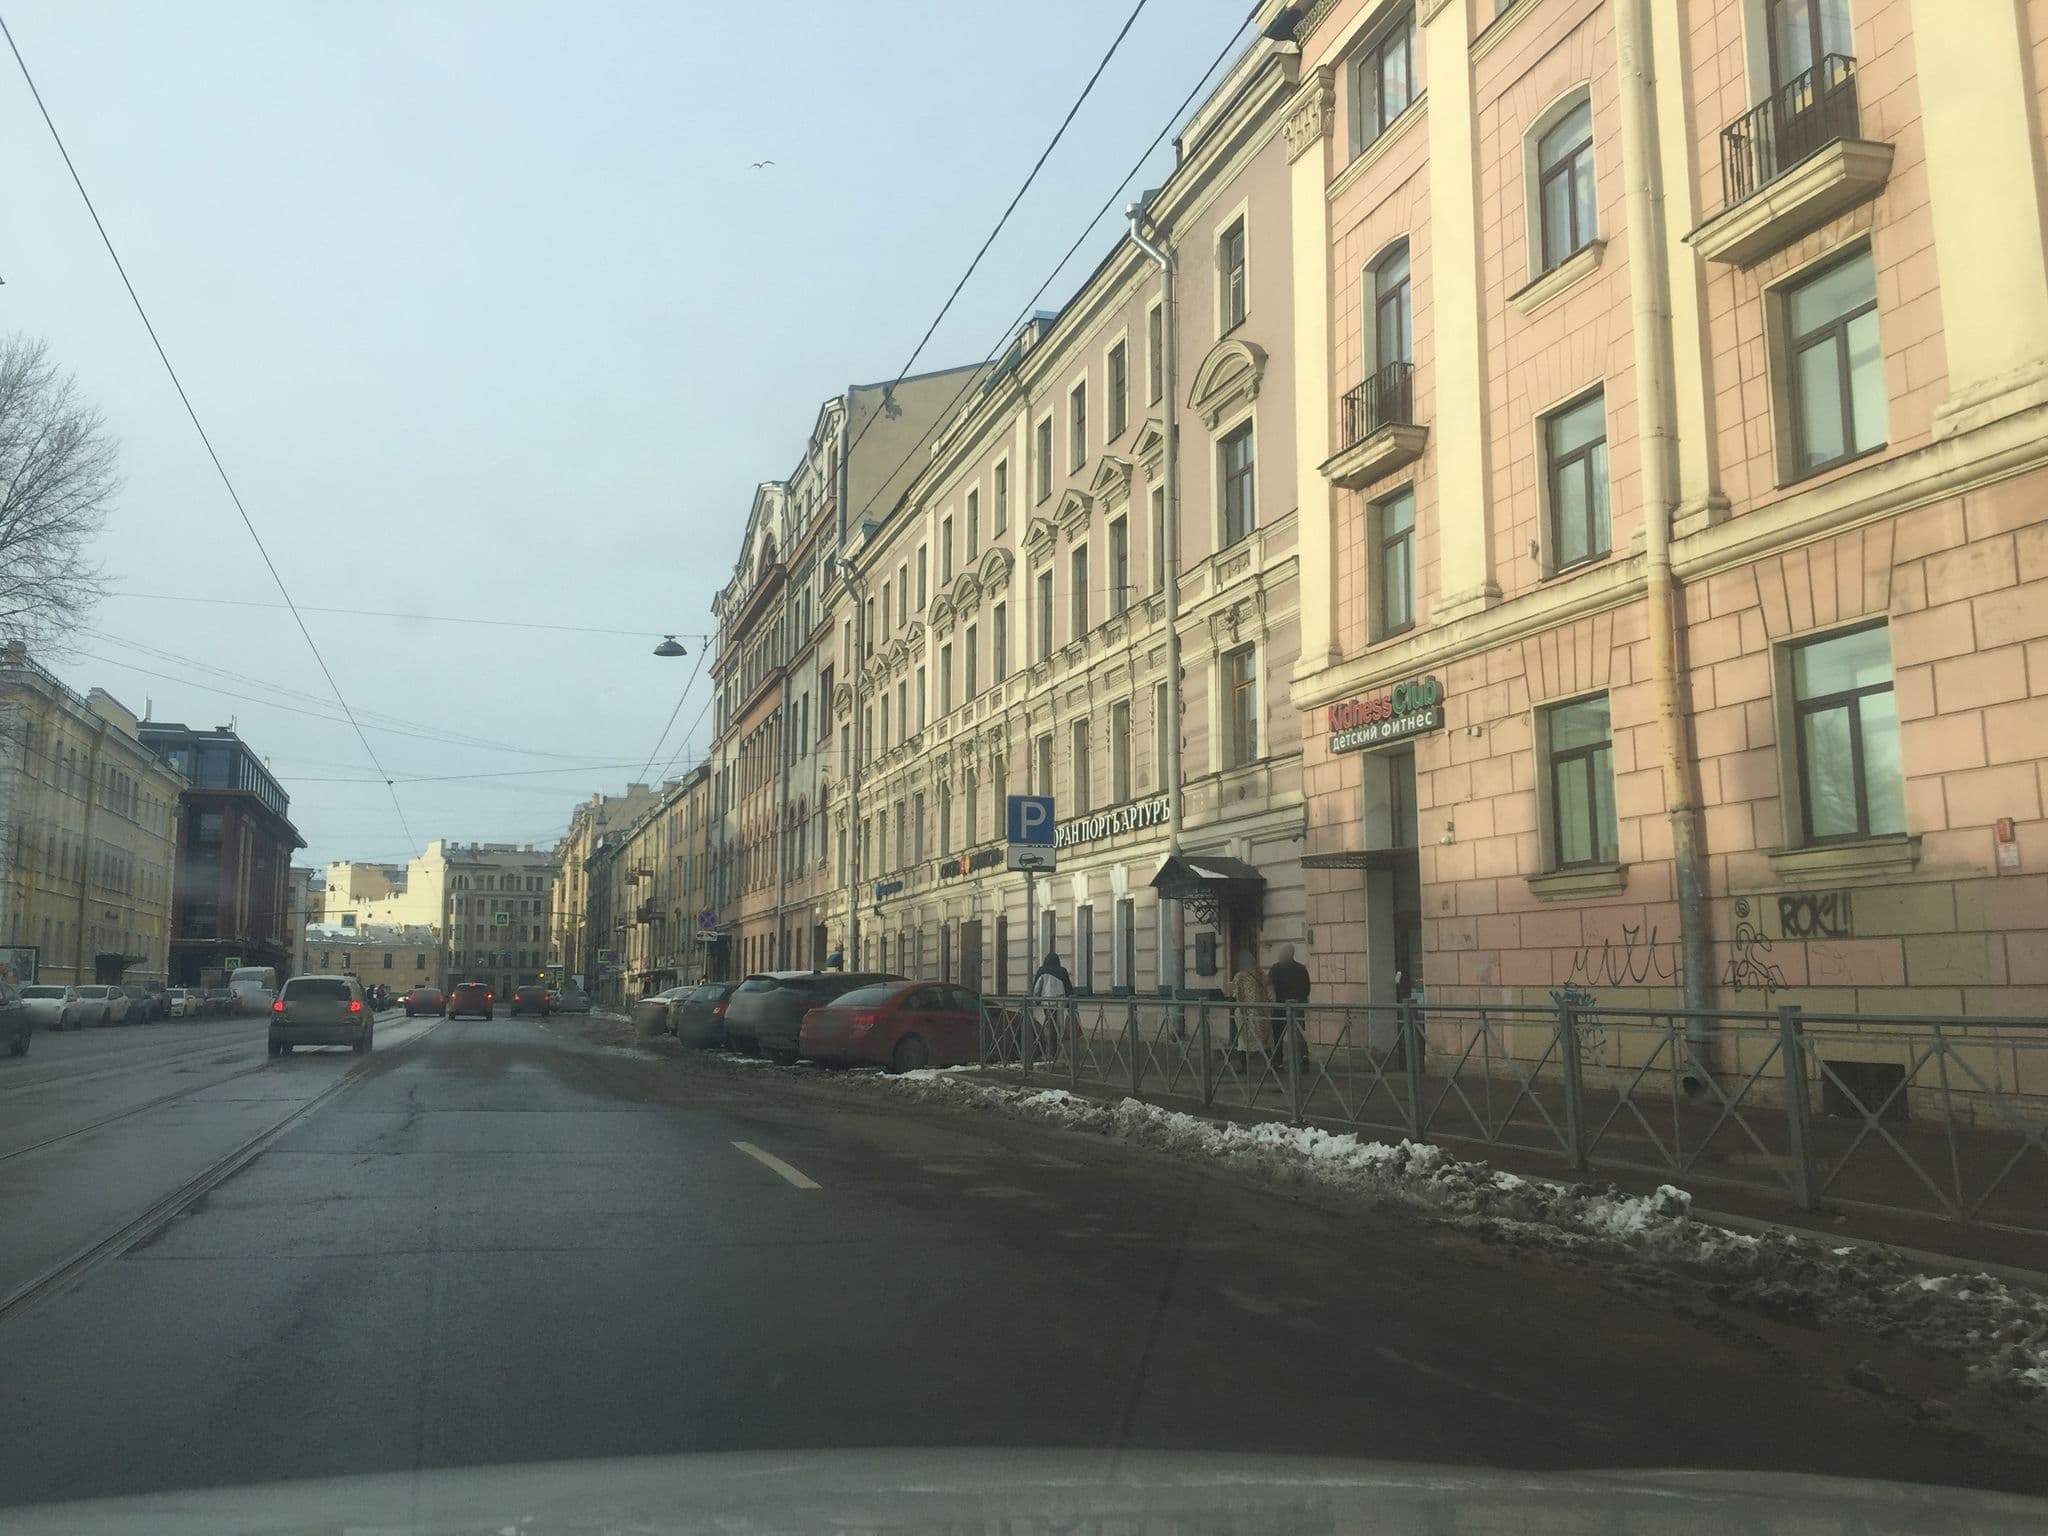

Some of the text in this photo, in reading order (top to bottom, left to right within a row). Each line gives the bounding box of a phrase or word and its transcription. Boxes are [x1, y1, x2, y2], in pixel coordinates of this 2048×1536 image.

[1021, 801, 1047, 839] P
[1081, 812, 1120, 842] ПОРТЪ
[1121, 798, 1170, 831] АРТУРЪ
